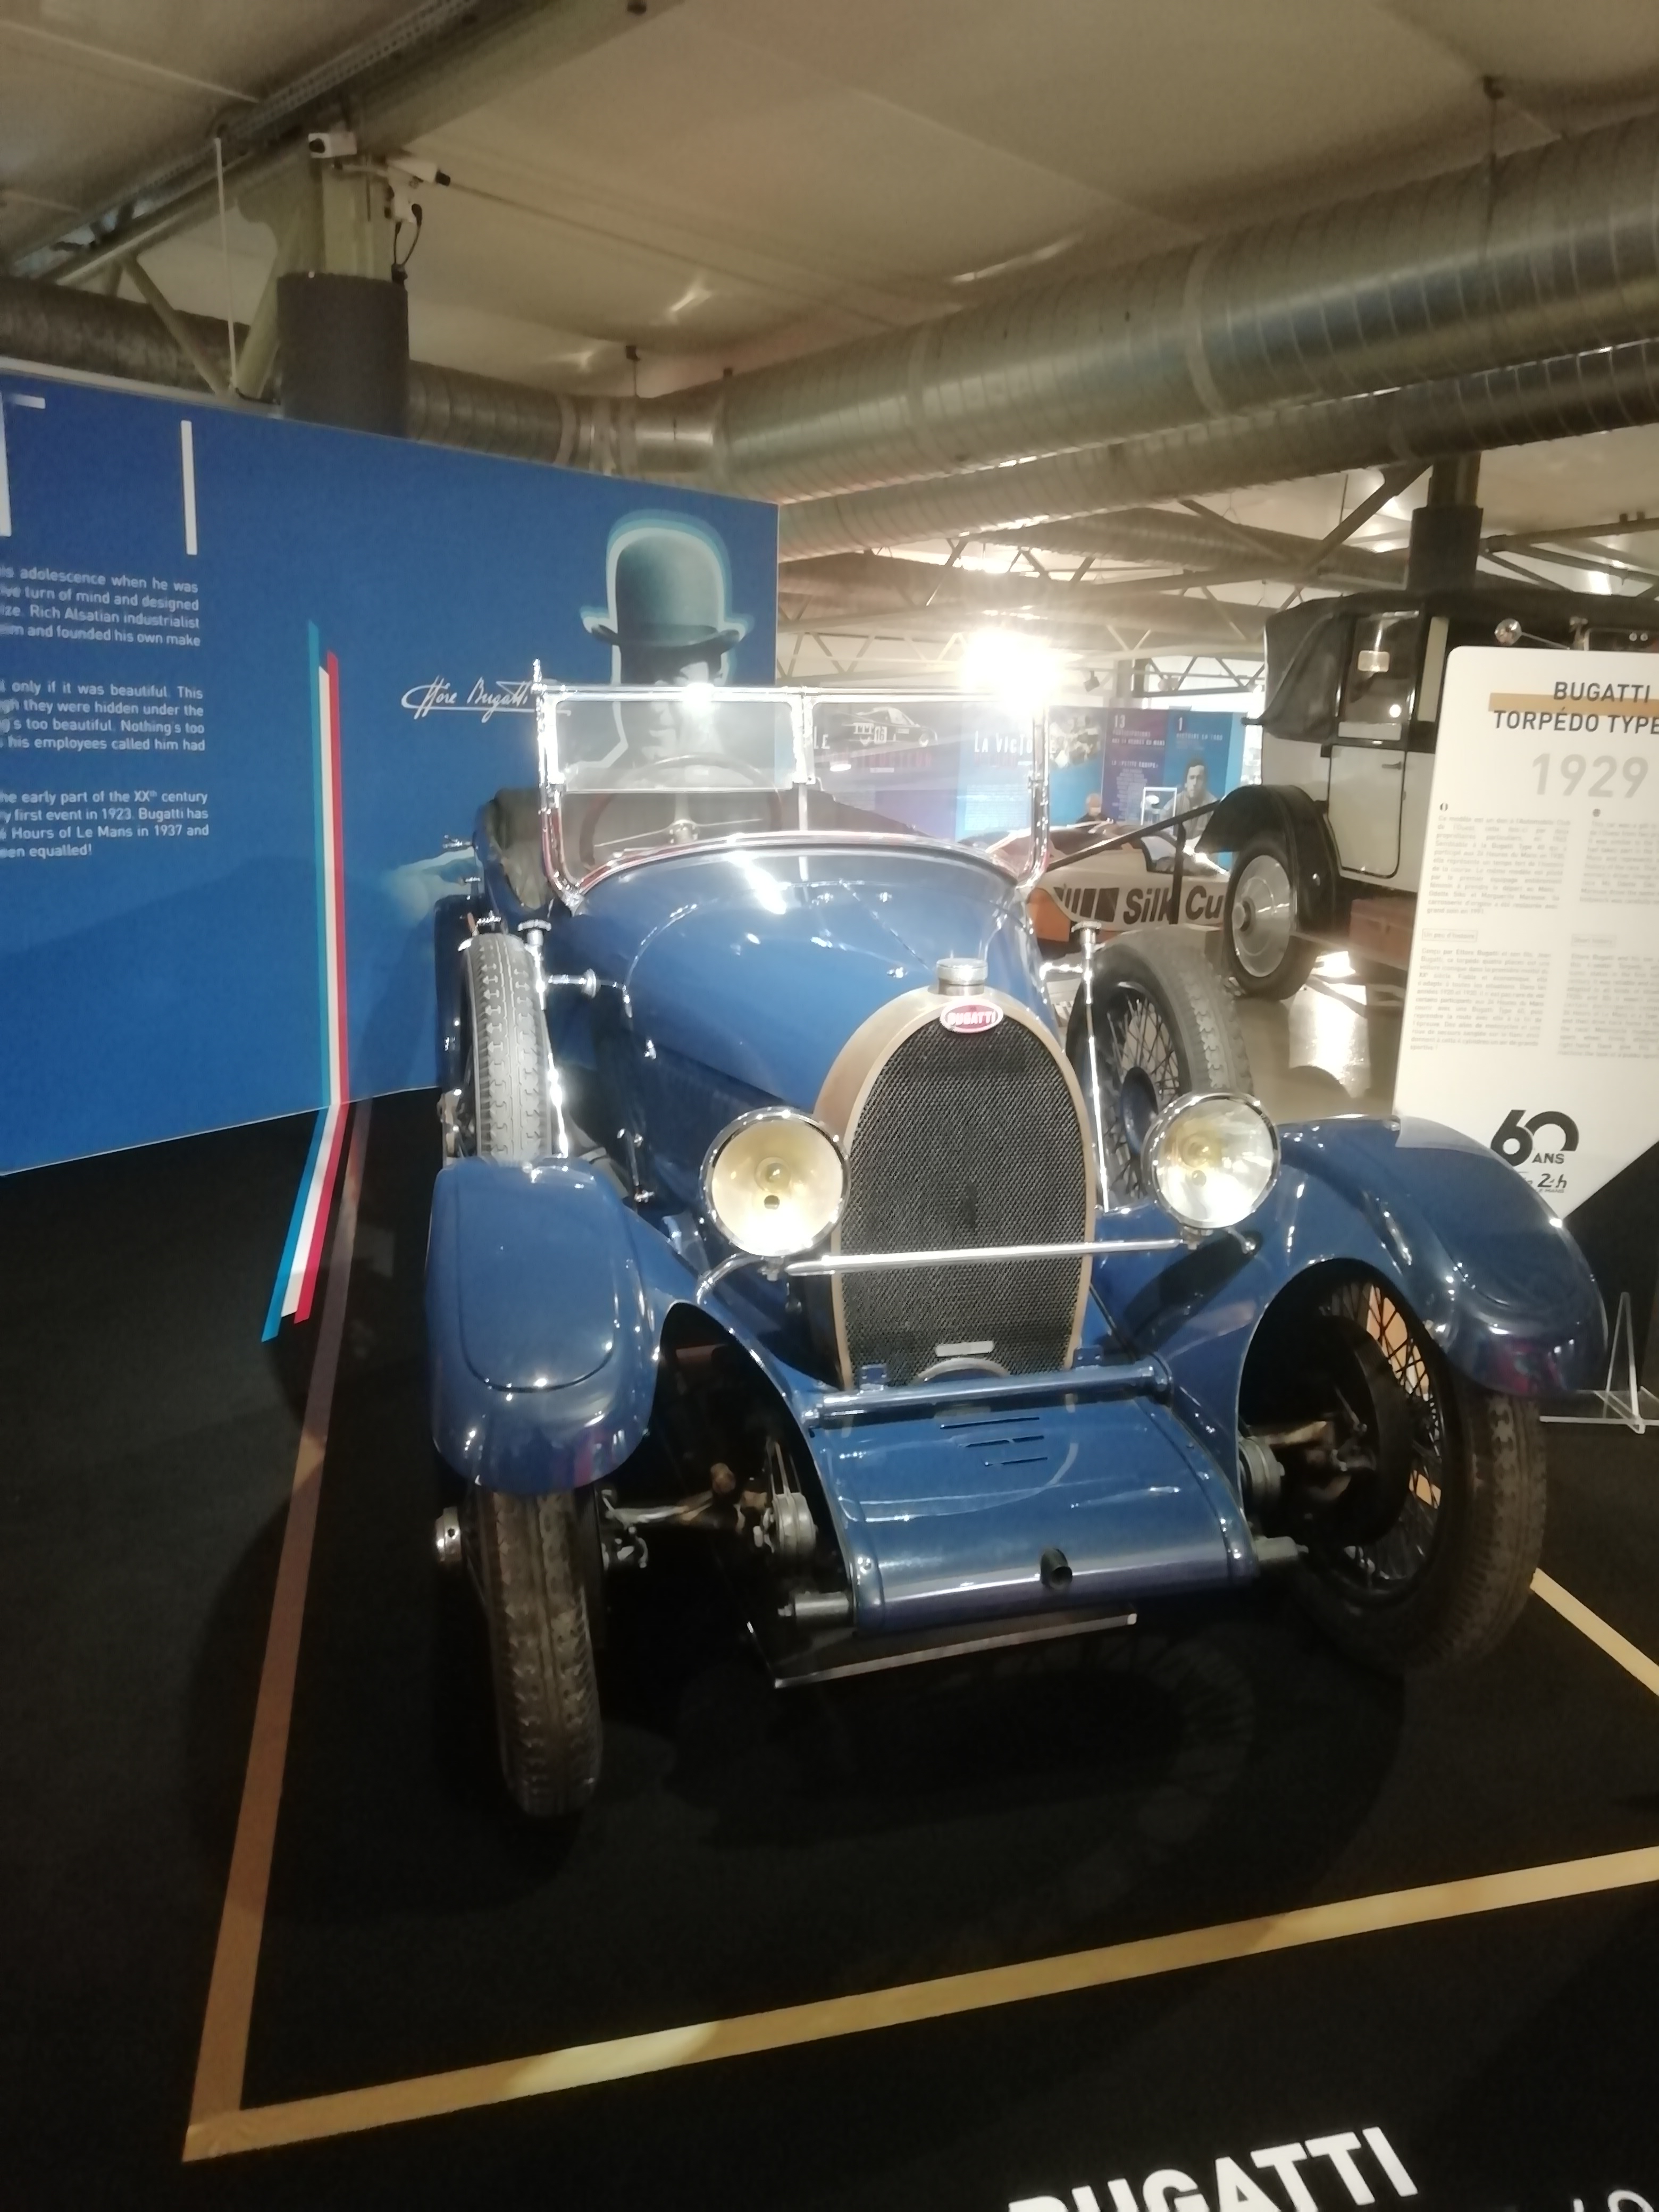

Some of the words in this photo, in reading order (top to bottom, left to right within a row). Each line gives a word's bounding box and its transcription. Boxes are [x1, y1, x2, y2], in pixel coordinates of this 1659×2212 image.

[20, 567, 106, 585] adolescence
[111, 575, 146, 589] when
[153, 577, 167, 591] he
[174, 581, 198, 593] was
[25, 586, 54, 599] turn
[59, 589, 71, 601] of
[76, 591, 110, 604] mind
[114, 594, 138, 607] and
[142, 595, 199, 613] designed
[30, 605, 60, 618] Rich
[64, 608, 119, 623] Alsatian
[124, 613, 199, 629] industrialist
[28, 625, 53, 637] and
[56, 625, 111, 641] founded
[115, 630, 133, 642] his
[137, 633, 163, 643] own
[166, 634, 200, 646] make
[12, 680, 41, 696] only
[48, 681, 55, 693] if
[63, 682, 71, 693] it
[78, 685, 104, 694] was
[177, 685, 203, 699] This
[1553, 682, 1650, 703] BUGATTI
[24, 699, 53, 715] they
[57, 702, 90, 713] were
[95, 701, 138, 715] hidden
[143, 703, 179, 716] under
[184, 704, 203, 717] the
[26, 718, 48, 731] too
[185, 723, 204, 734] too
[1115, 715, 1126, 728] 13
[1178, 717, 1183, 731] 1
[1494, 707, 1599, 732] TORPÉDO
[1607, 715, 1659, 735] TYPE
[7, 735, 30, 749] his
[34, 737, 107, 752] employees
[111, 738, 150, 750] called
[155, 739, 178, 750] him
[182, 739, 205, 751] had
[1532, 752, 1648, 799] 1929
[21, 790, 56, 805] early
[61, 791, 88, 805] part
[93, 791, 104, 803] of
[109, 791, 130, 802] the
[162, 791, 208, 804] century
[14, 809, 42, 821] first
[46, 809, 82, 821] event
[86, 809, 97, 820] in
[138, 807, 183, 823] Bugatti
[187, 808, 208, 819] has
[12, 826, 54, 840] Hours
[59, 826, 71, 839] of
[77, 826, 93, 838] Le
[98, 825, 132, 838] Mans
[138, 825, 148, 837] in
[154, 824, 182, 836] 1937
[187, 824, 209, 836] and
[29, 843, 92, 859] equalled!
[1186, 885, 1224, 920] Cu
[948, 1011, 996, 1025] BUGATTI
[1532, 1153, 1564, 1164] ANS
